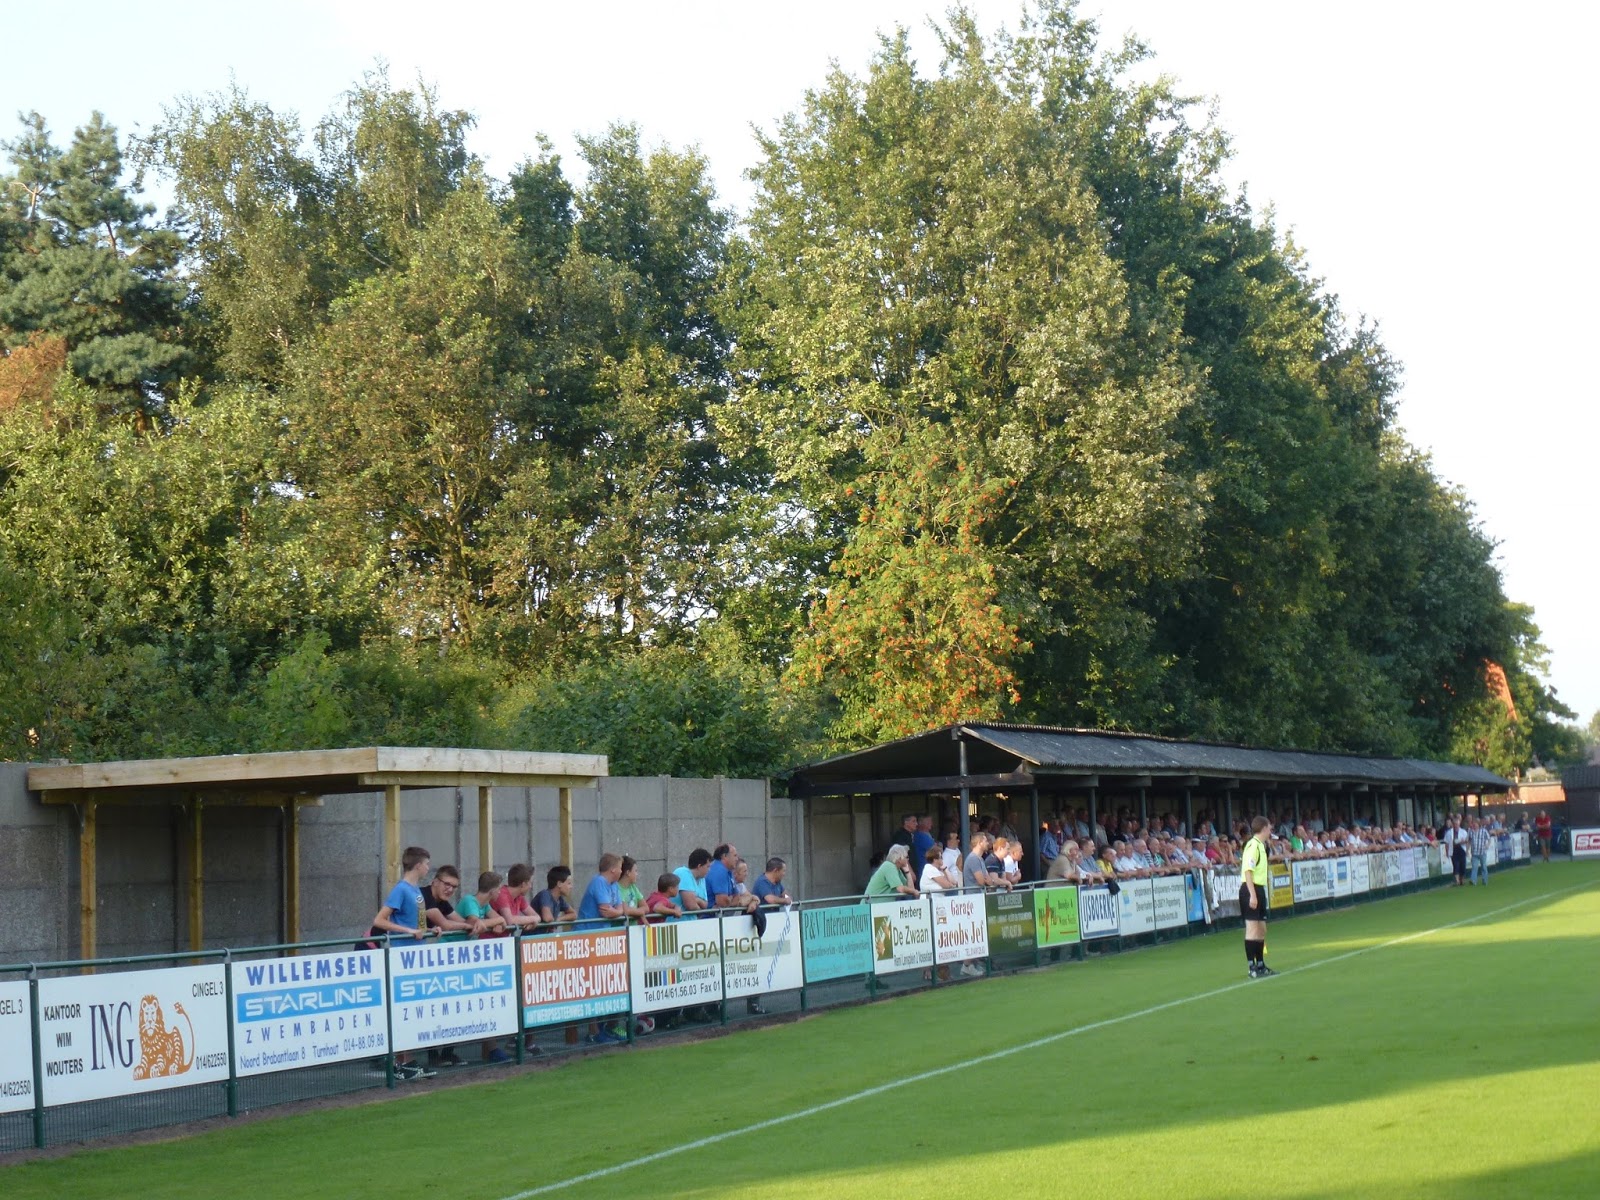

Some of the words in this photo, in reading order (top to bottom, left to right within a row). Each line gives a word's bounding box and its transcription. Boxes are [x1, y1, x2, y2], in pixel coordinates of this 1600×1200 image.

[900, 906, 922, 920] Herberg
[951, 900, 974, 918] Garage
[805, 912, 821, 940] P&V
[823, 907, 870, 938] Interieurbouw
[893, 926, 904, 946] De
[905, 924, 929, 944] Zwaan
[938, 922, 968, 948] Jacobs
[970, 920, 984, 944] Jef
[400, 943, 503, 969] WILLEMSEN
[523, 940, 557, 963] VLOEREN
[563, 938, 589, 960] TEGELS
[596, 934, 626, 956] GRANIET
[767, 920, 791, 988] printing
[246, 955, 372, 986] WILLEMSEN
[737, 962, 758, 974] Vosselaar
[192, 982, 218, 998] CINGEL
[219, 981, 224, 994] 3
[401, 971, 504, 997] STARLINE
[524, 962, 628, 1004] CNAEPKENS-LUYCKX
[700, 982, 711, 994] Fax
[18, 999, 23, 1014] 3
[44, 1004, 81, 1021] KANTOOR
[246, 986, 373, 1017] STARLINE
[403, 995, 506, 1021] ZWEMBADEN
[56, 1032, 72, 1048] WIM
[89, 1001, 134, 1070] ING
[246, 1013, 371, 1044] ZWEMBADEN
[418, 1019, 497, 1042] www.willemsenzwembaden.be
[46, 1058, 83, 1077] WOUTERS
[196, 1052, 227, 1070] 014/622550
[240, 1054, 260, 1069] Noord
[262, 1048, 299, 1066] Brabantlaan
[301, 1047, 306, 1059] 8
[313, 1043, 339, 1058] Turnhout
